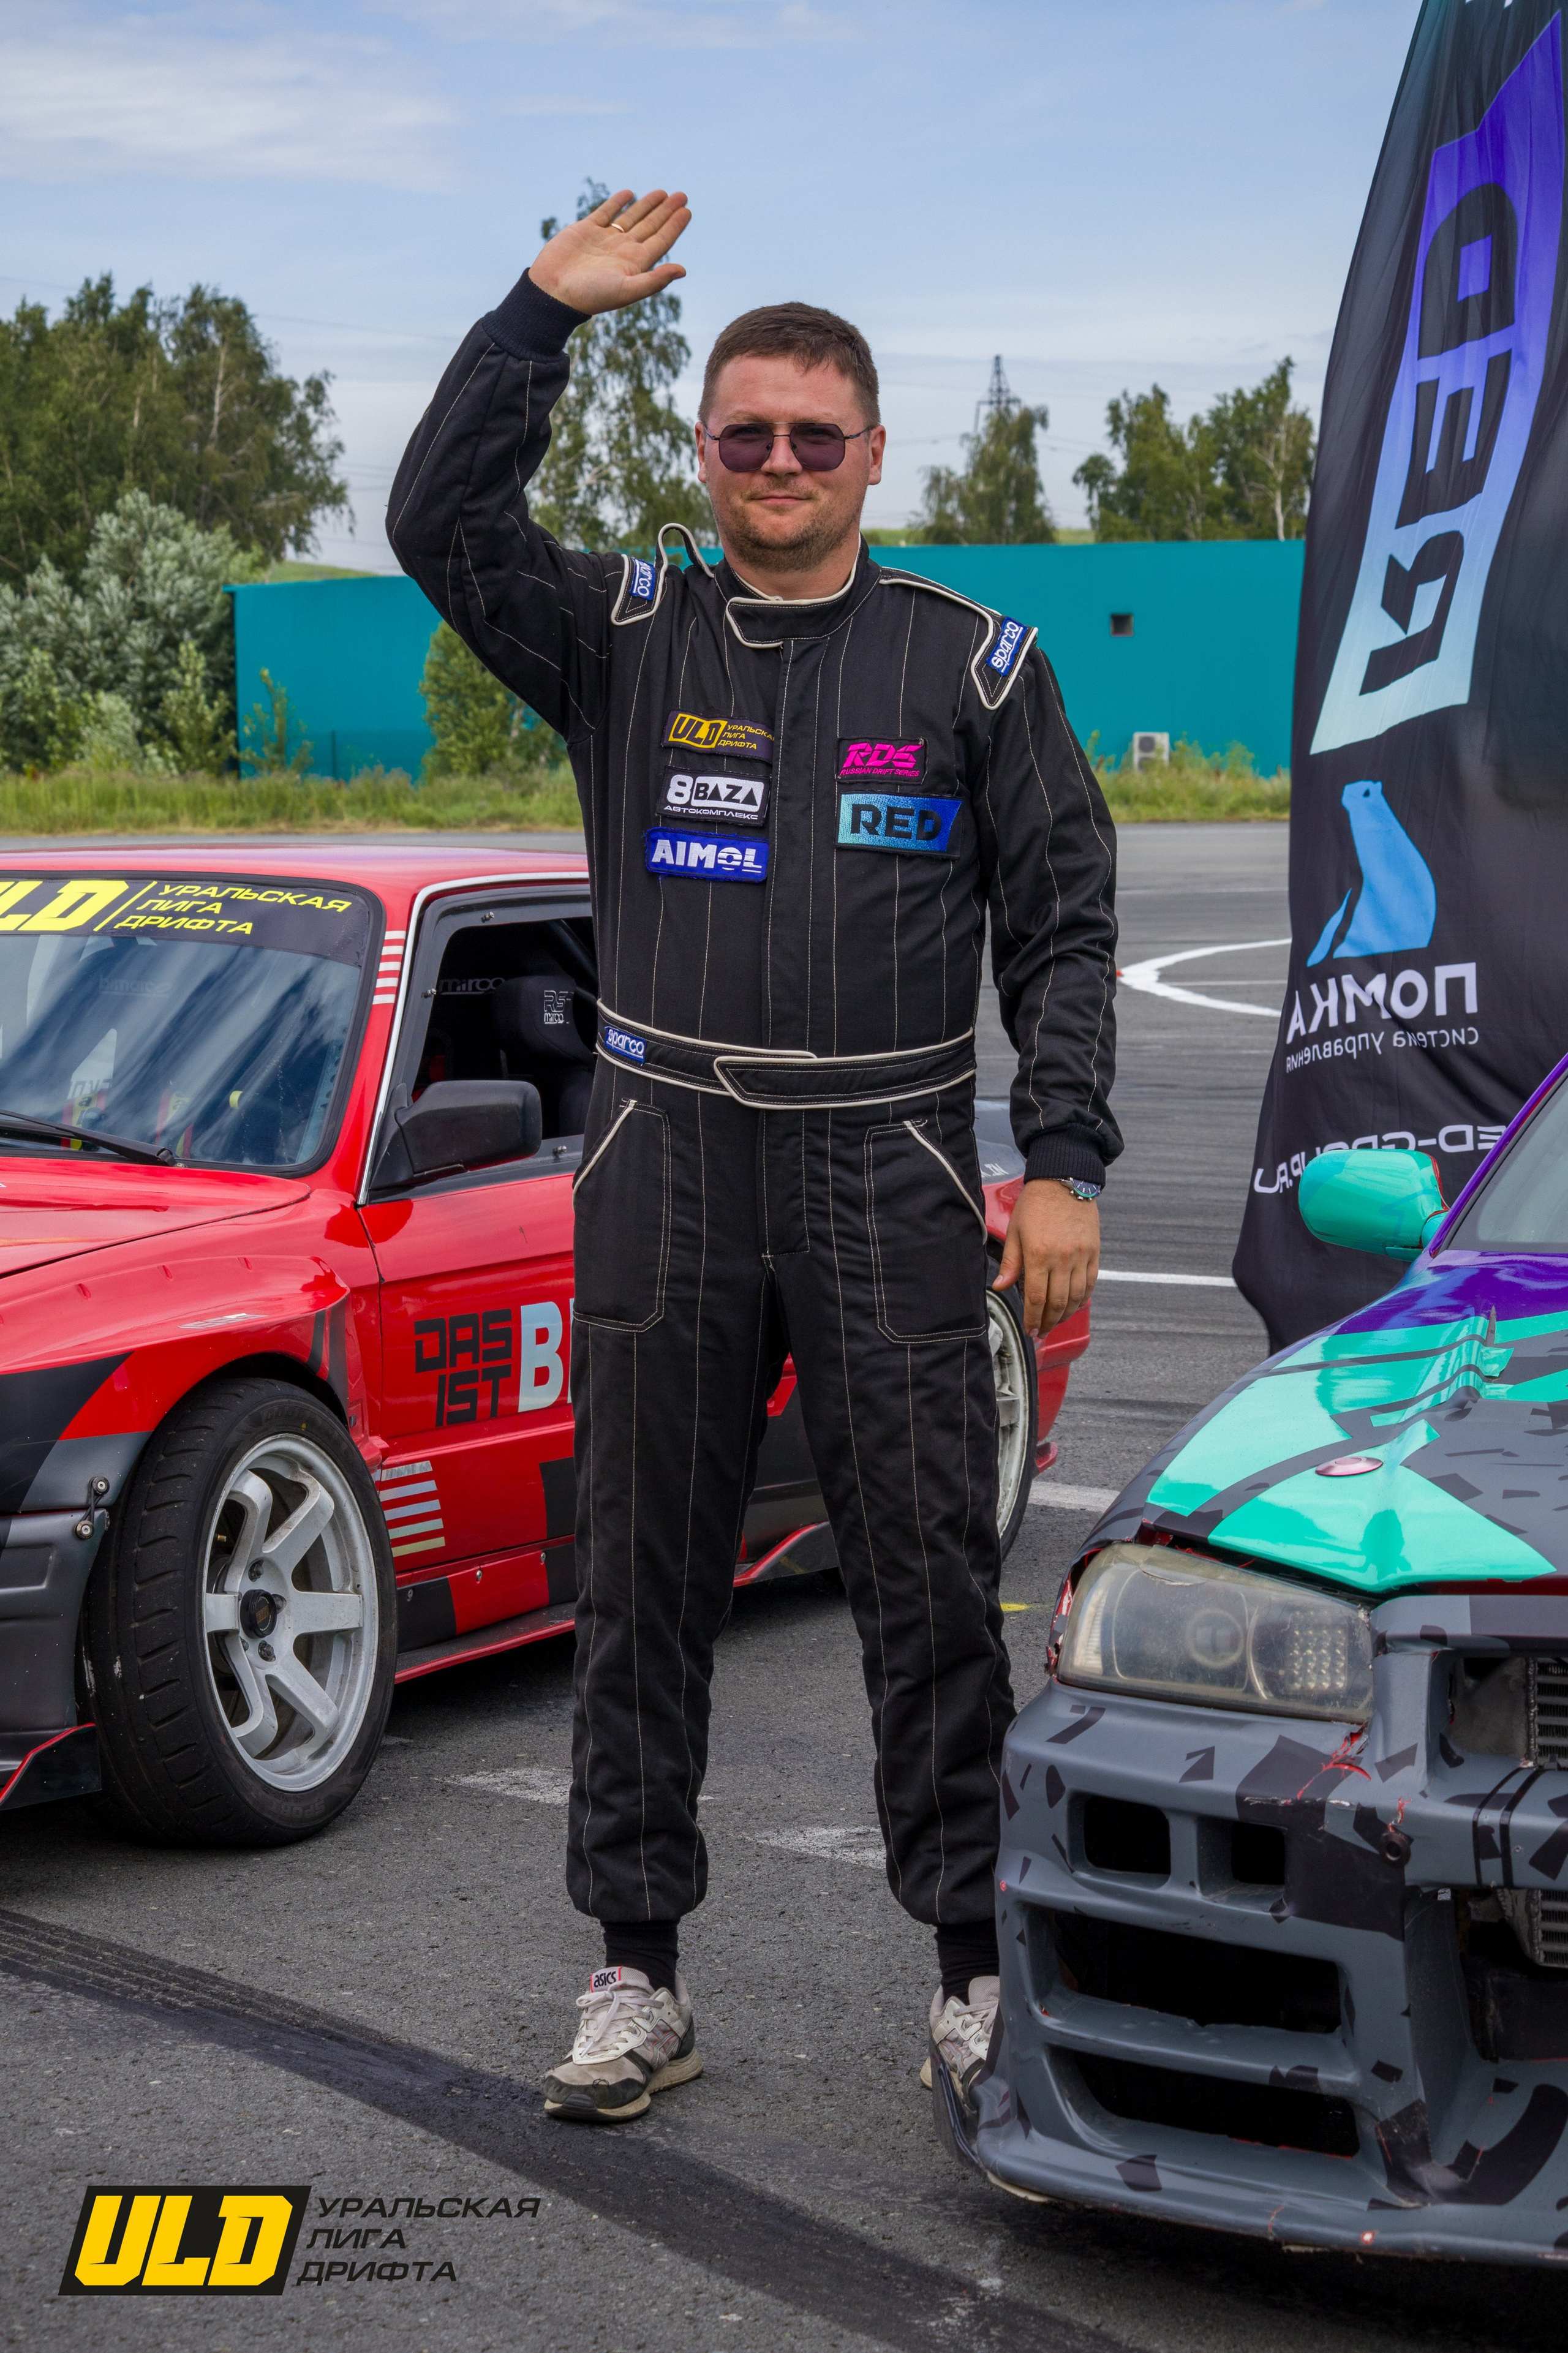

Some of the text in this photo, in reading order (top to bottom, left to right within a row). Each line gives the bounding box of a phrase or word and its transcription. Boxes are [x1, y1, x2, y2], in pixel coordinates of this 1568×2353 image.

[991, 621, 1019, 668] sparco
[672, 716, 722, 745] ULD
[717, 740, 756, 750] ДРИФТА
[842, 743, 924, 768] RDS
[840, 767, 872, 776] RUSSIAN
[663, 805, 758, 819] АВТОКОМПЛЕКС
[851, 804, 941, 841] RED
[652, 839, 762, 873] AIMOL
[0, 880, 129, 931] LD
[136, 900, 222, 914] ЛИГА
[158, 884, 352, 913] УРАЛЬСКАЯ
[113, 915, 254, 935] ДРИФТА
[608, 1029, 644, 1055] sparco
[414, 1298, 575, 1412] DAS B
[435, 1363, 511, 1428] IST
[594, 1971, 617, 1988] asics
